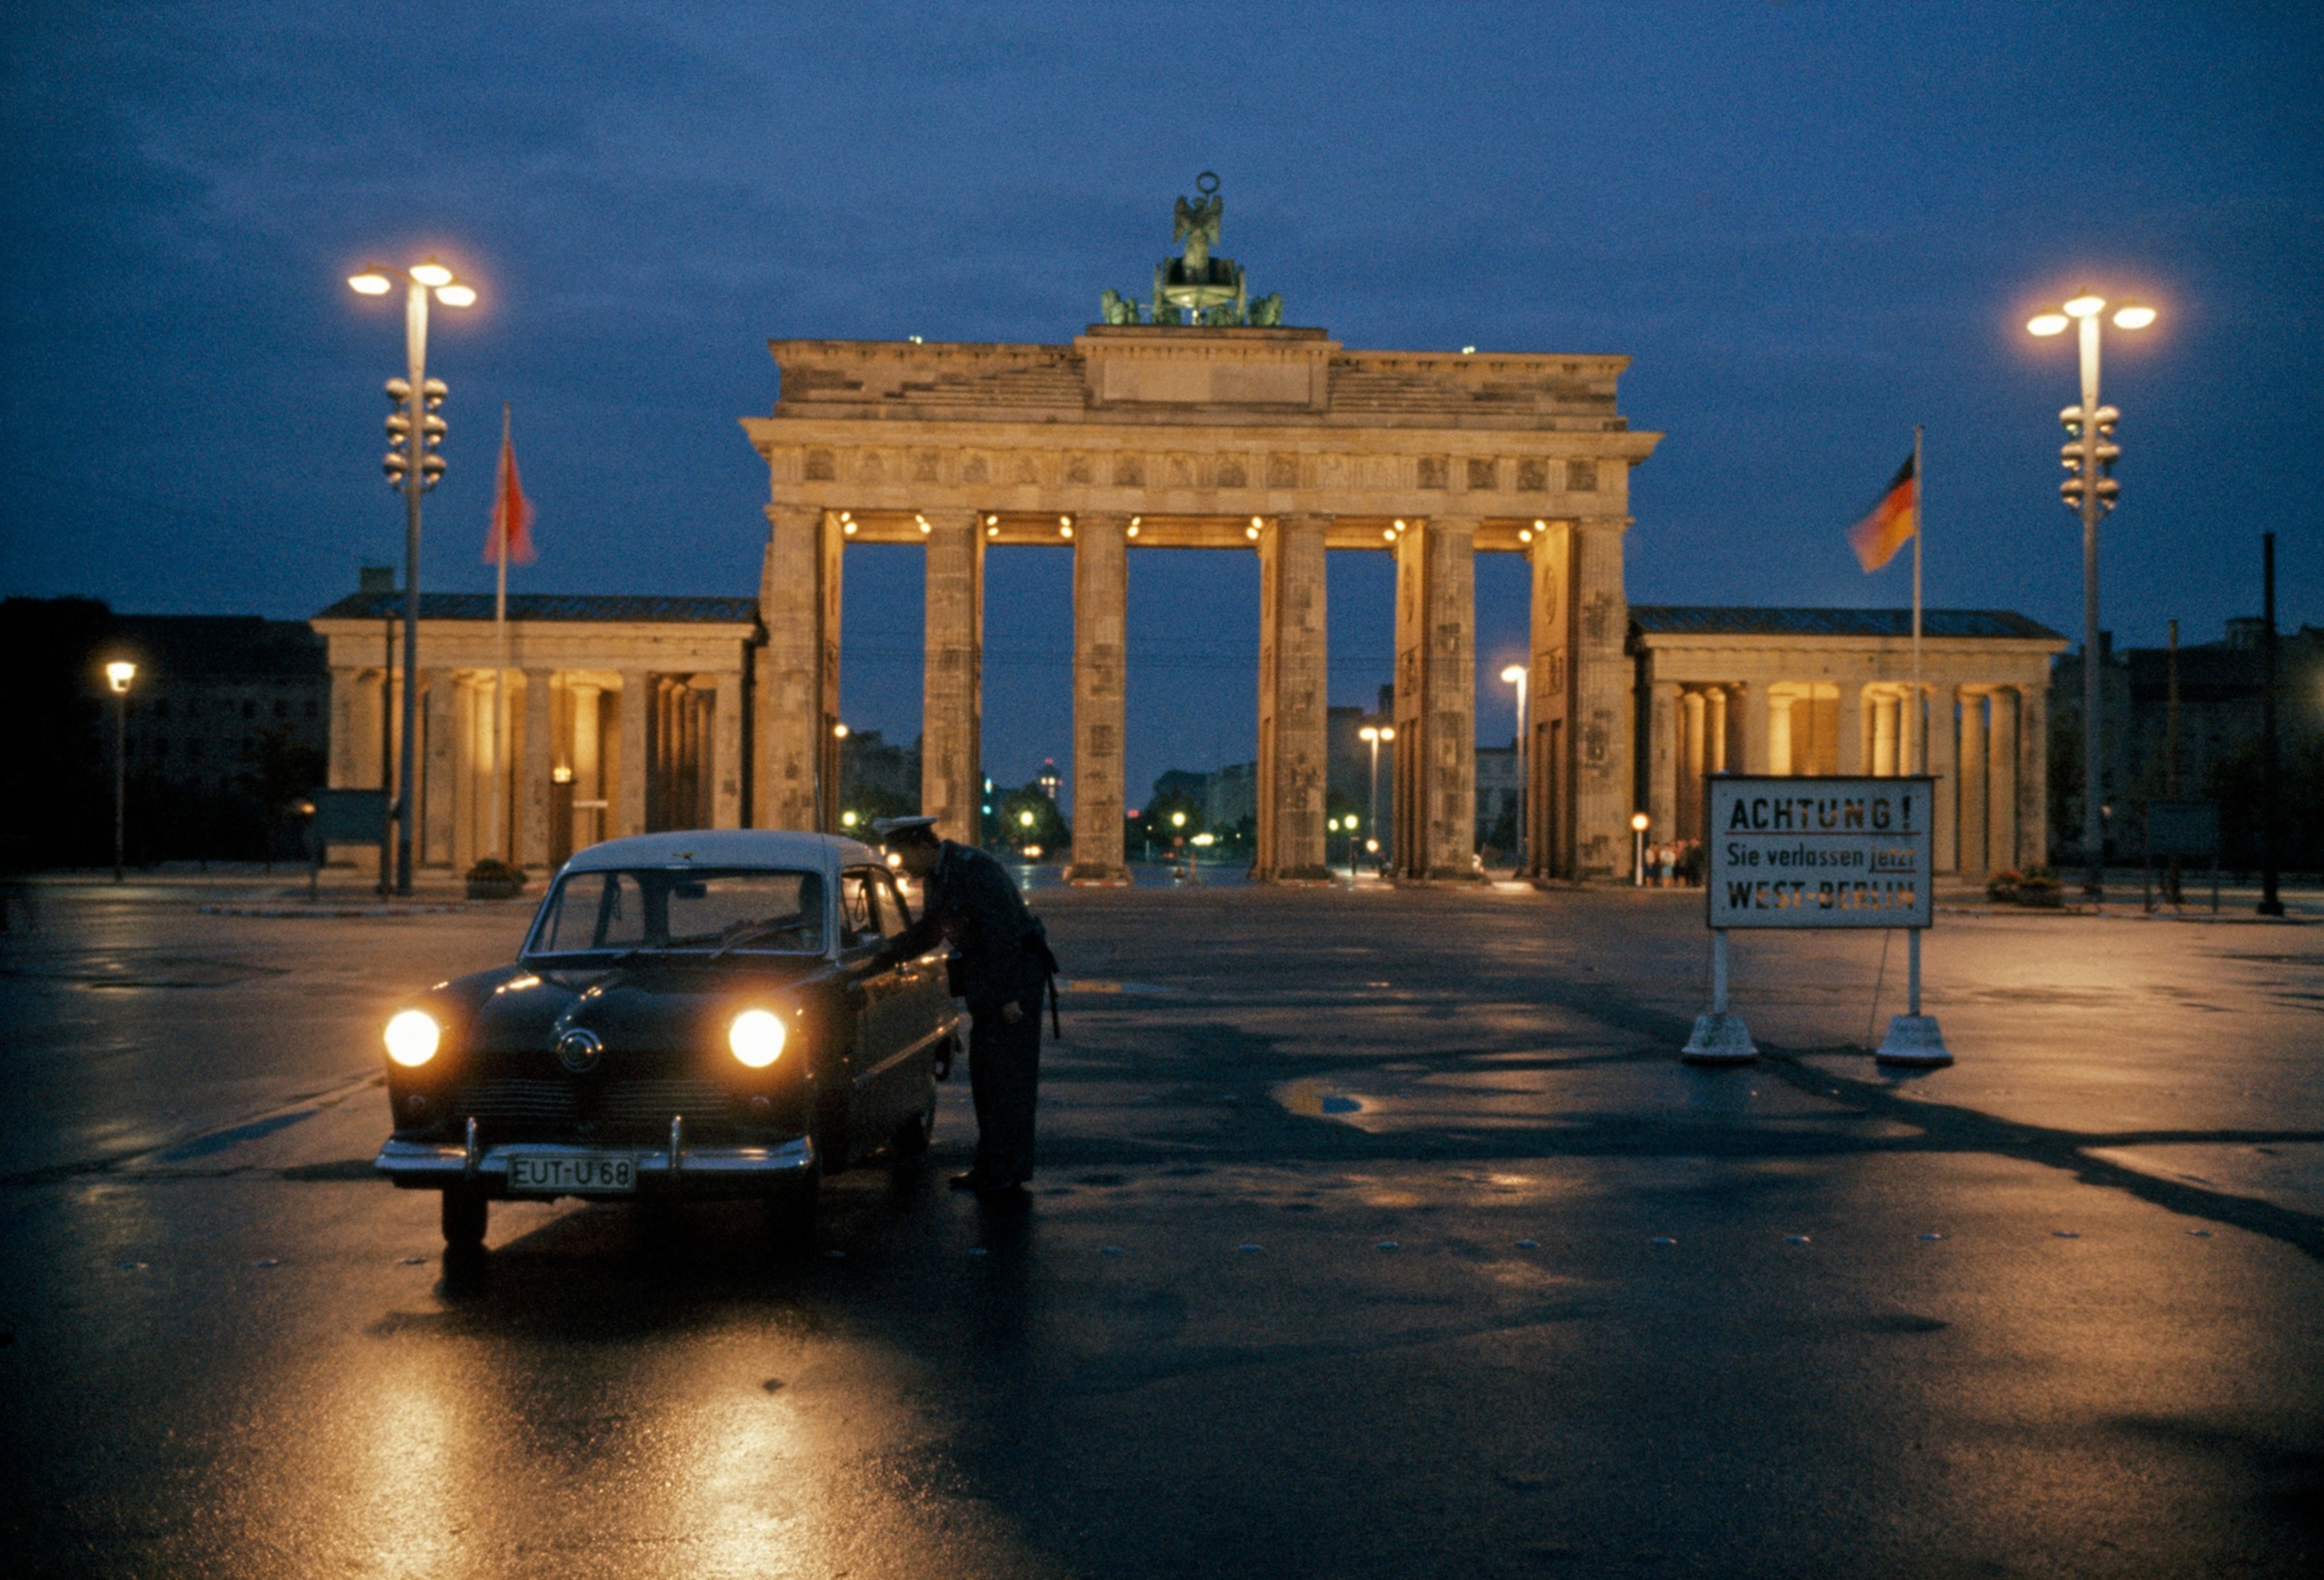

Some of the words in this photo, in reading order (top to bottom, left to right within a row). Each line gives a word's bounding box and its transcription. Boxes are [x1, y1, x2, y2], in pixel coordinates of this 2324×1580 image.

[1729, 796, 1911, 829] ACHTUNG!
[1727, 842, 1760, 866] Sie
[1767, 842, 1863, 866] verlassen
[1869, 845, 1915, 870] jetzt
[1727, 881, 1915, 909] WEST-BERLIN
[514, 1161, 592, 1184] EUT-U
[600, 1162, 629, 1184] 68
